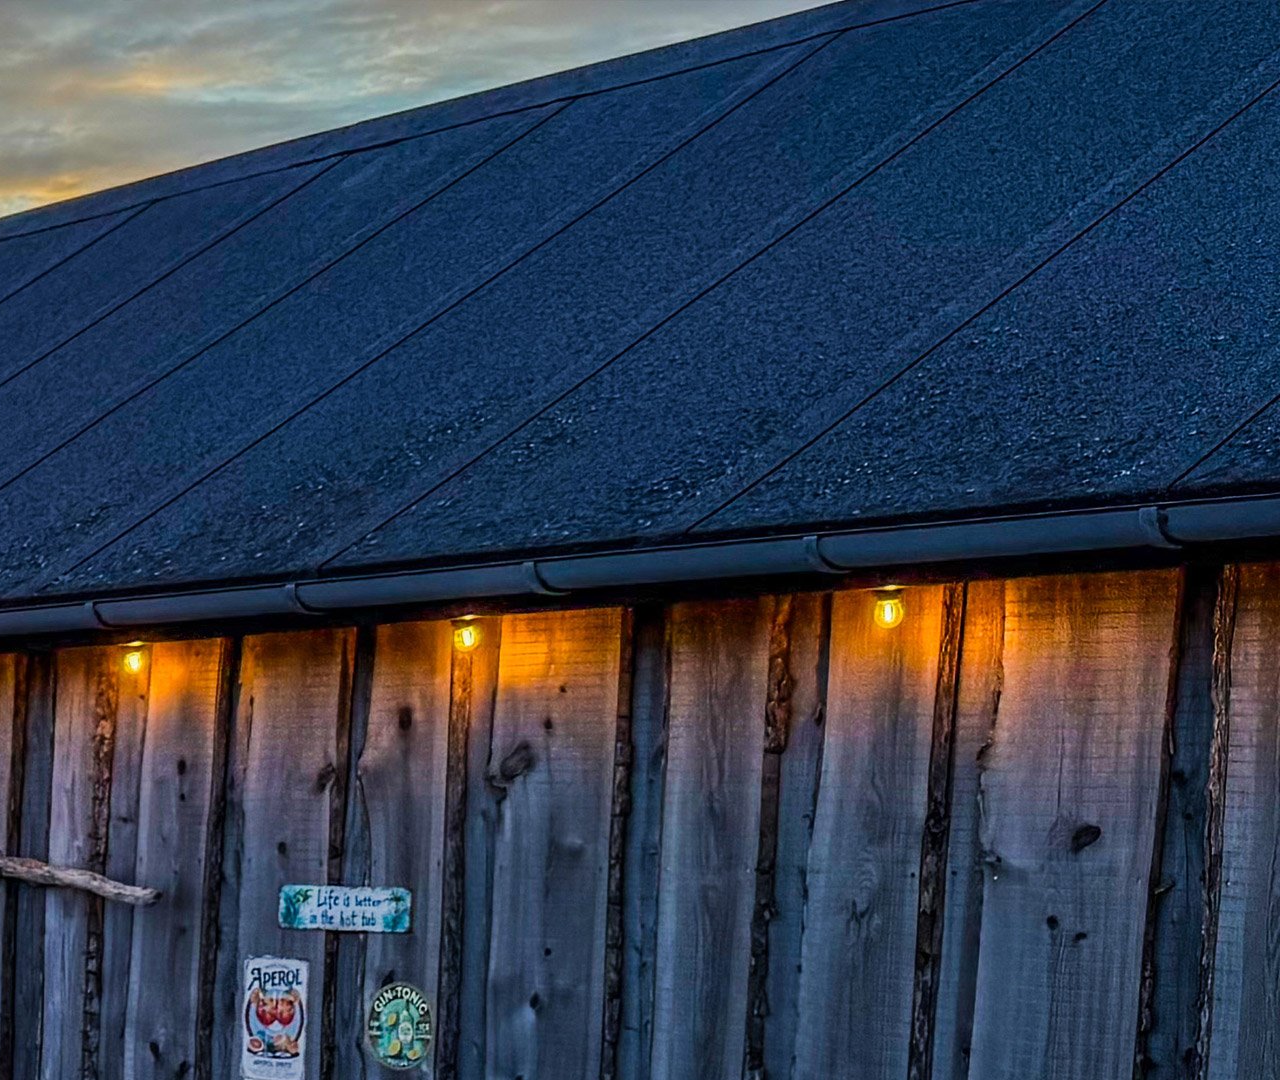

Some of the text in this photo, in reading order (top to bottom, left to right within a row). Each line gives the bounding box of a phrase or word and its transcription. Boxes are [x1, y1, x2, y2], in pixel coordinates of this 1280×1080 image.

[317, 889, 382, 910] Life is better
[321, 909, 335, 925] the
[339, 910, 357, 927] hot
[361, 911, 377, 927] tub
[248, 967, 302, 991] APEROL
[395, 986, 428, 1015] TONIC
